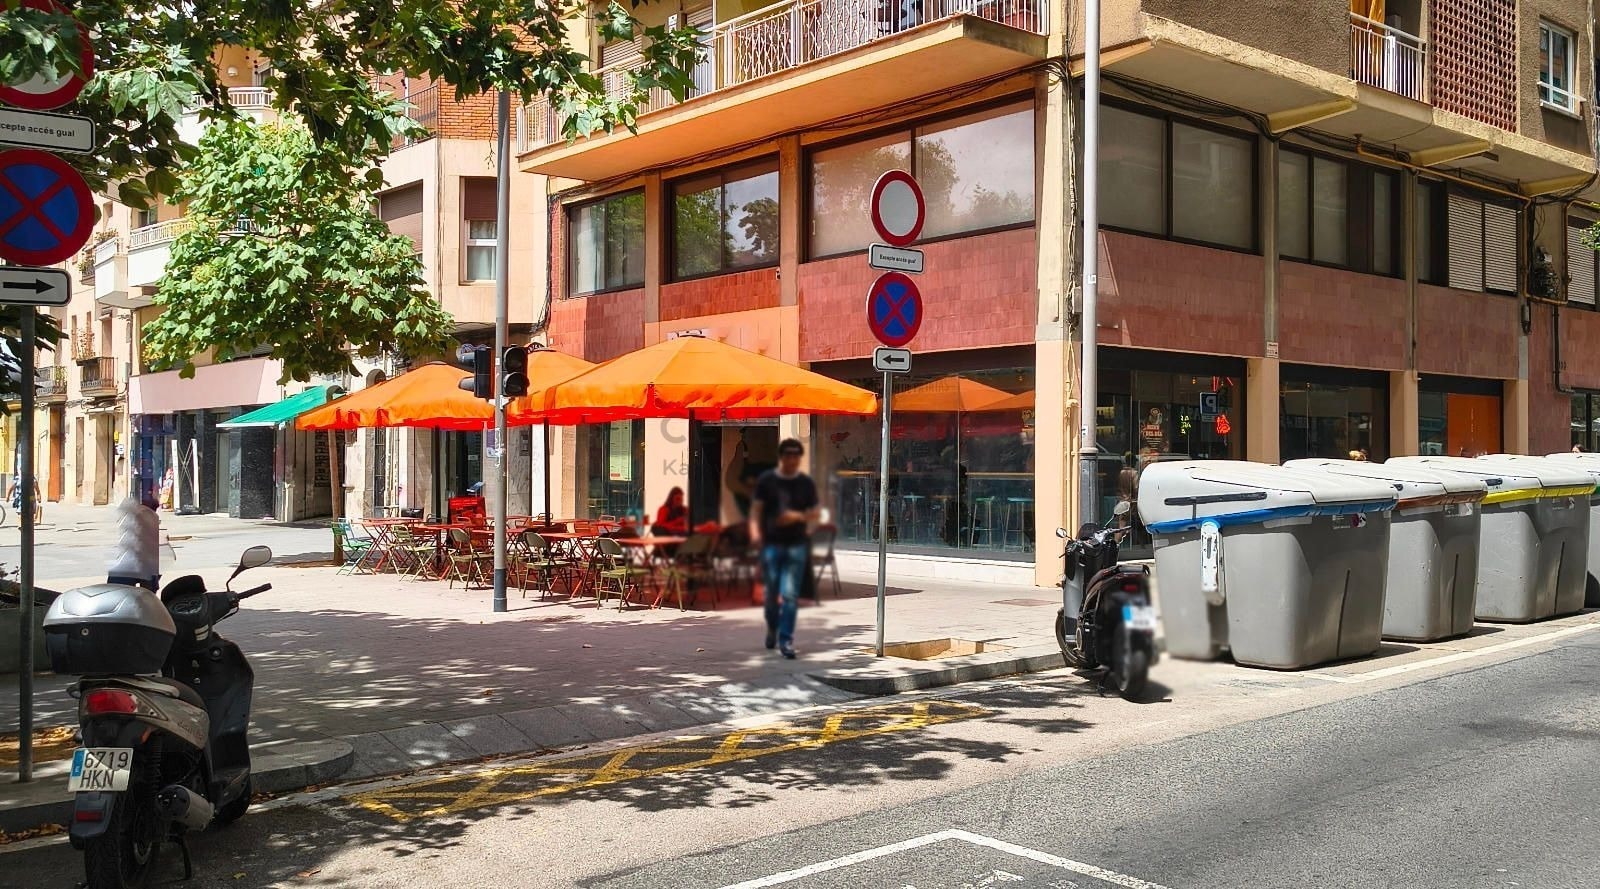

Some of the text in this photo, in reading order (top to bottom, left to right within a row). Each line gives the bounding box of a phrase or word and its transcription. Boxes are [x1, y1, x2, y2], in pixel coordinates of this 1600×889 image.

[0, 123, 75, 137] cepte accés gual
[84, 751, 129, 769] 6719
[80, 769, 115, 787] HKN
